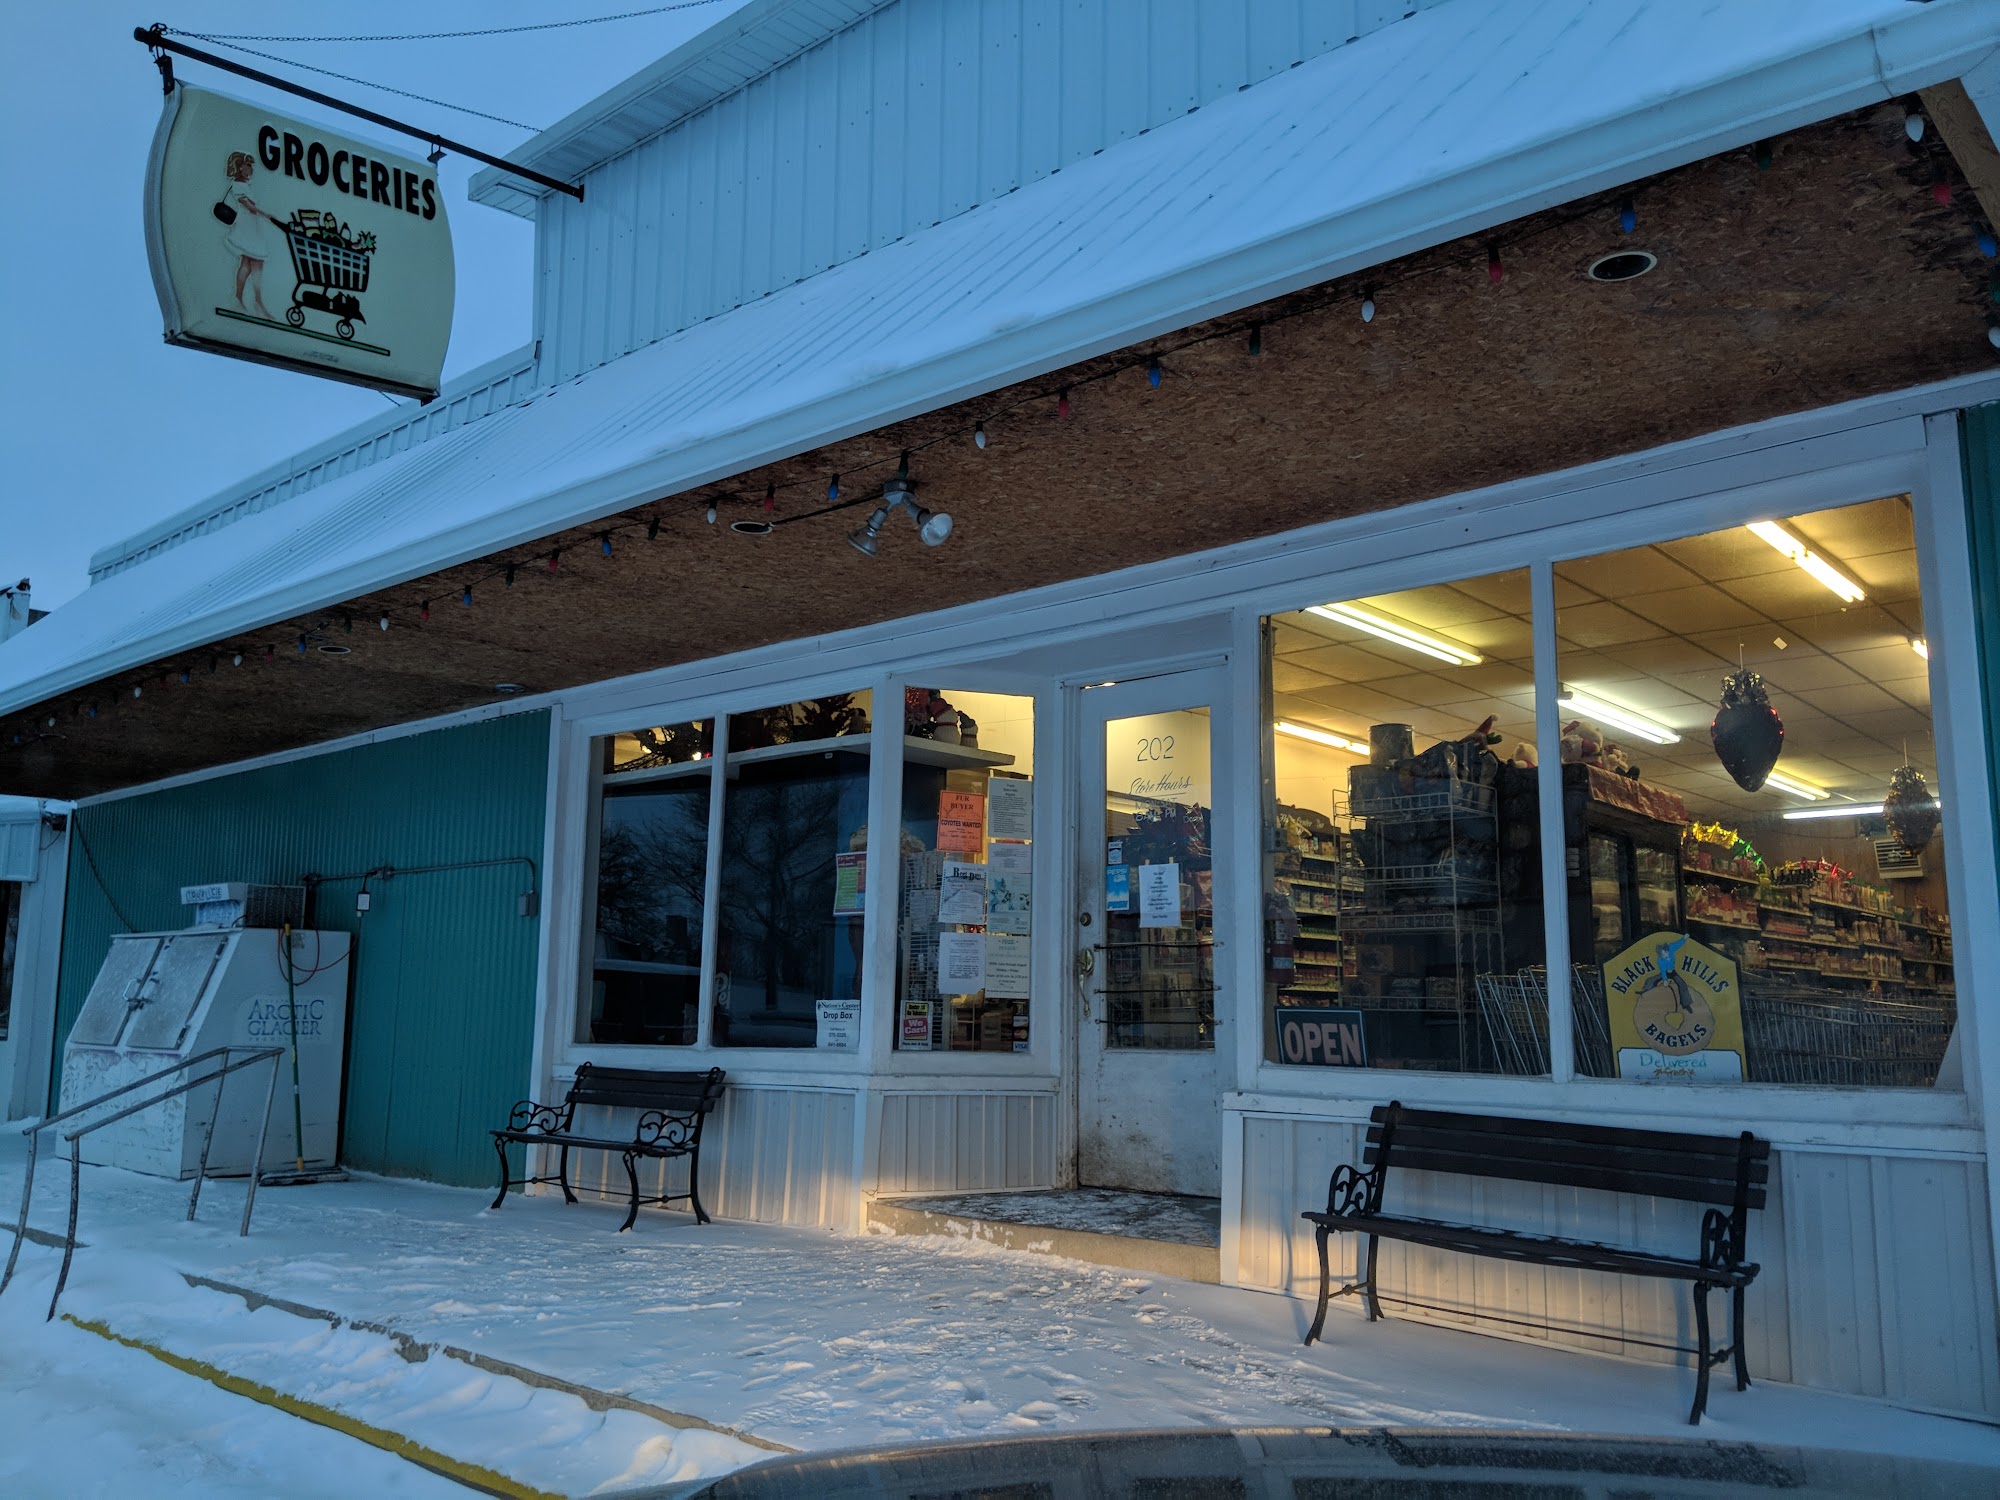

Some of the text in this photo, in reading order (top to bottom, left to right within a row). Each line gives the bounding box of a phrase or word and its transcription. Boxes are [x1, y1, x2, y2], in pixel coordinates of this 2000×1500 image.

[257, 124, 437, 221] GROCERIES
[1137, 735, 1175, 762] 202
[1129, 771, 1192, 795] Store Hours
[941, 819, 981, 829] COYOTES WANTED
[1106, 868, 1128, 876] PEPSI
[1611, 955, 1729, 995] BLACK HILLS
[248, 999, 325, 1020] ARCTIC
[821, 1001, 860, 1009] Nation's Center
[823, 1011, 853, 1020] Drop Box
[908, 1019, 924, 1027] We
[248, 1020, 322, 1036] GLACIER
[904, 1025, 927, 1035] Card
[1644, 1022, 1708, 1048] BAGELS
[1283, 1021, 1363, 1065] OPEN
[1640, 1052, 1707, 1068] Delivered
